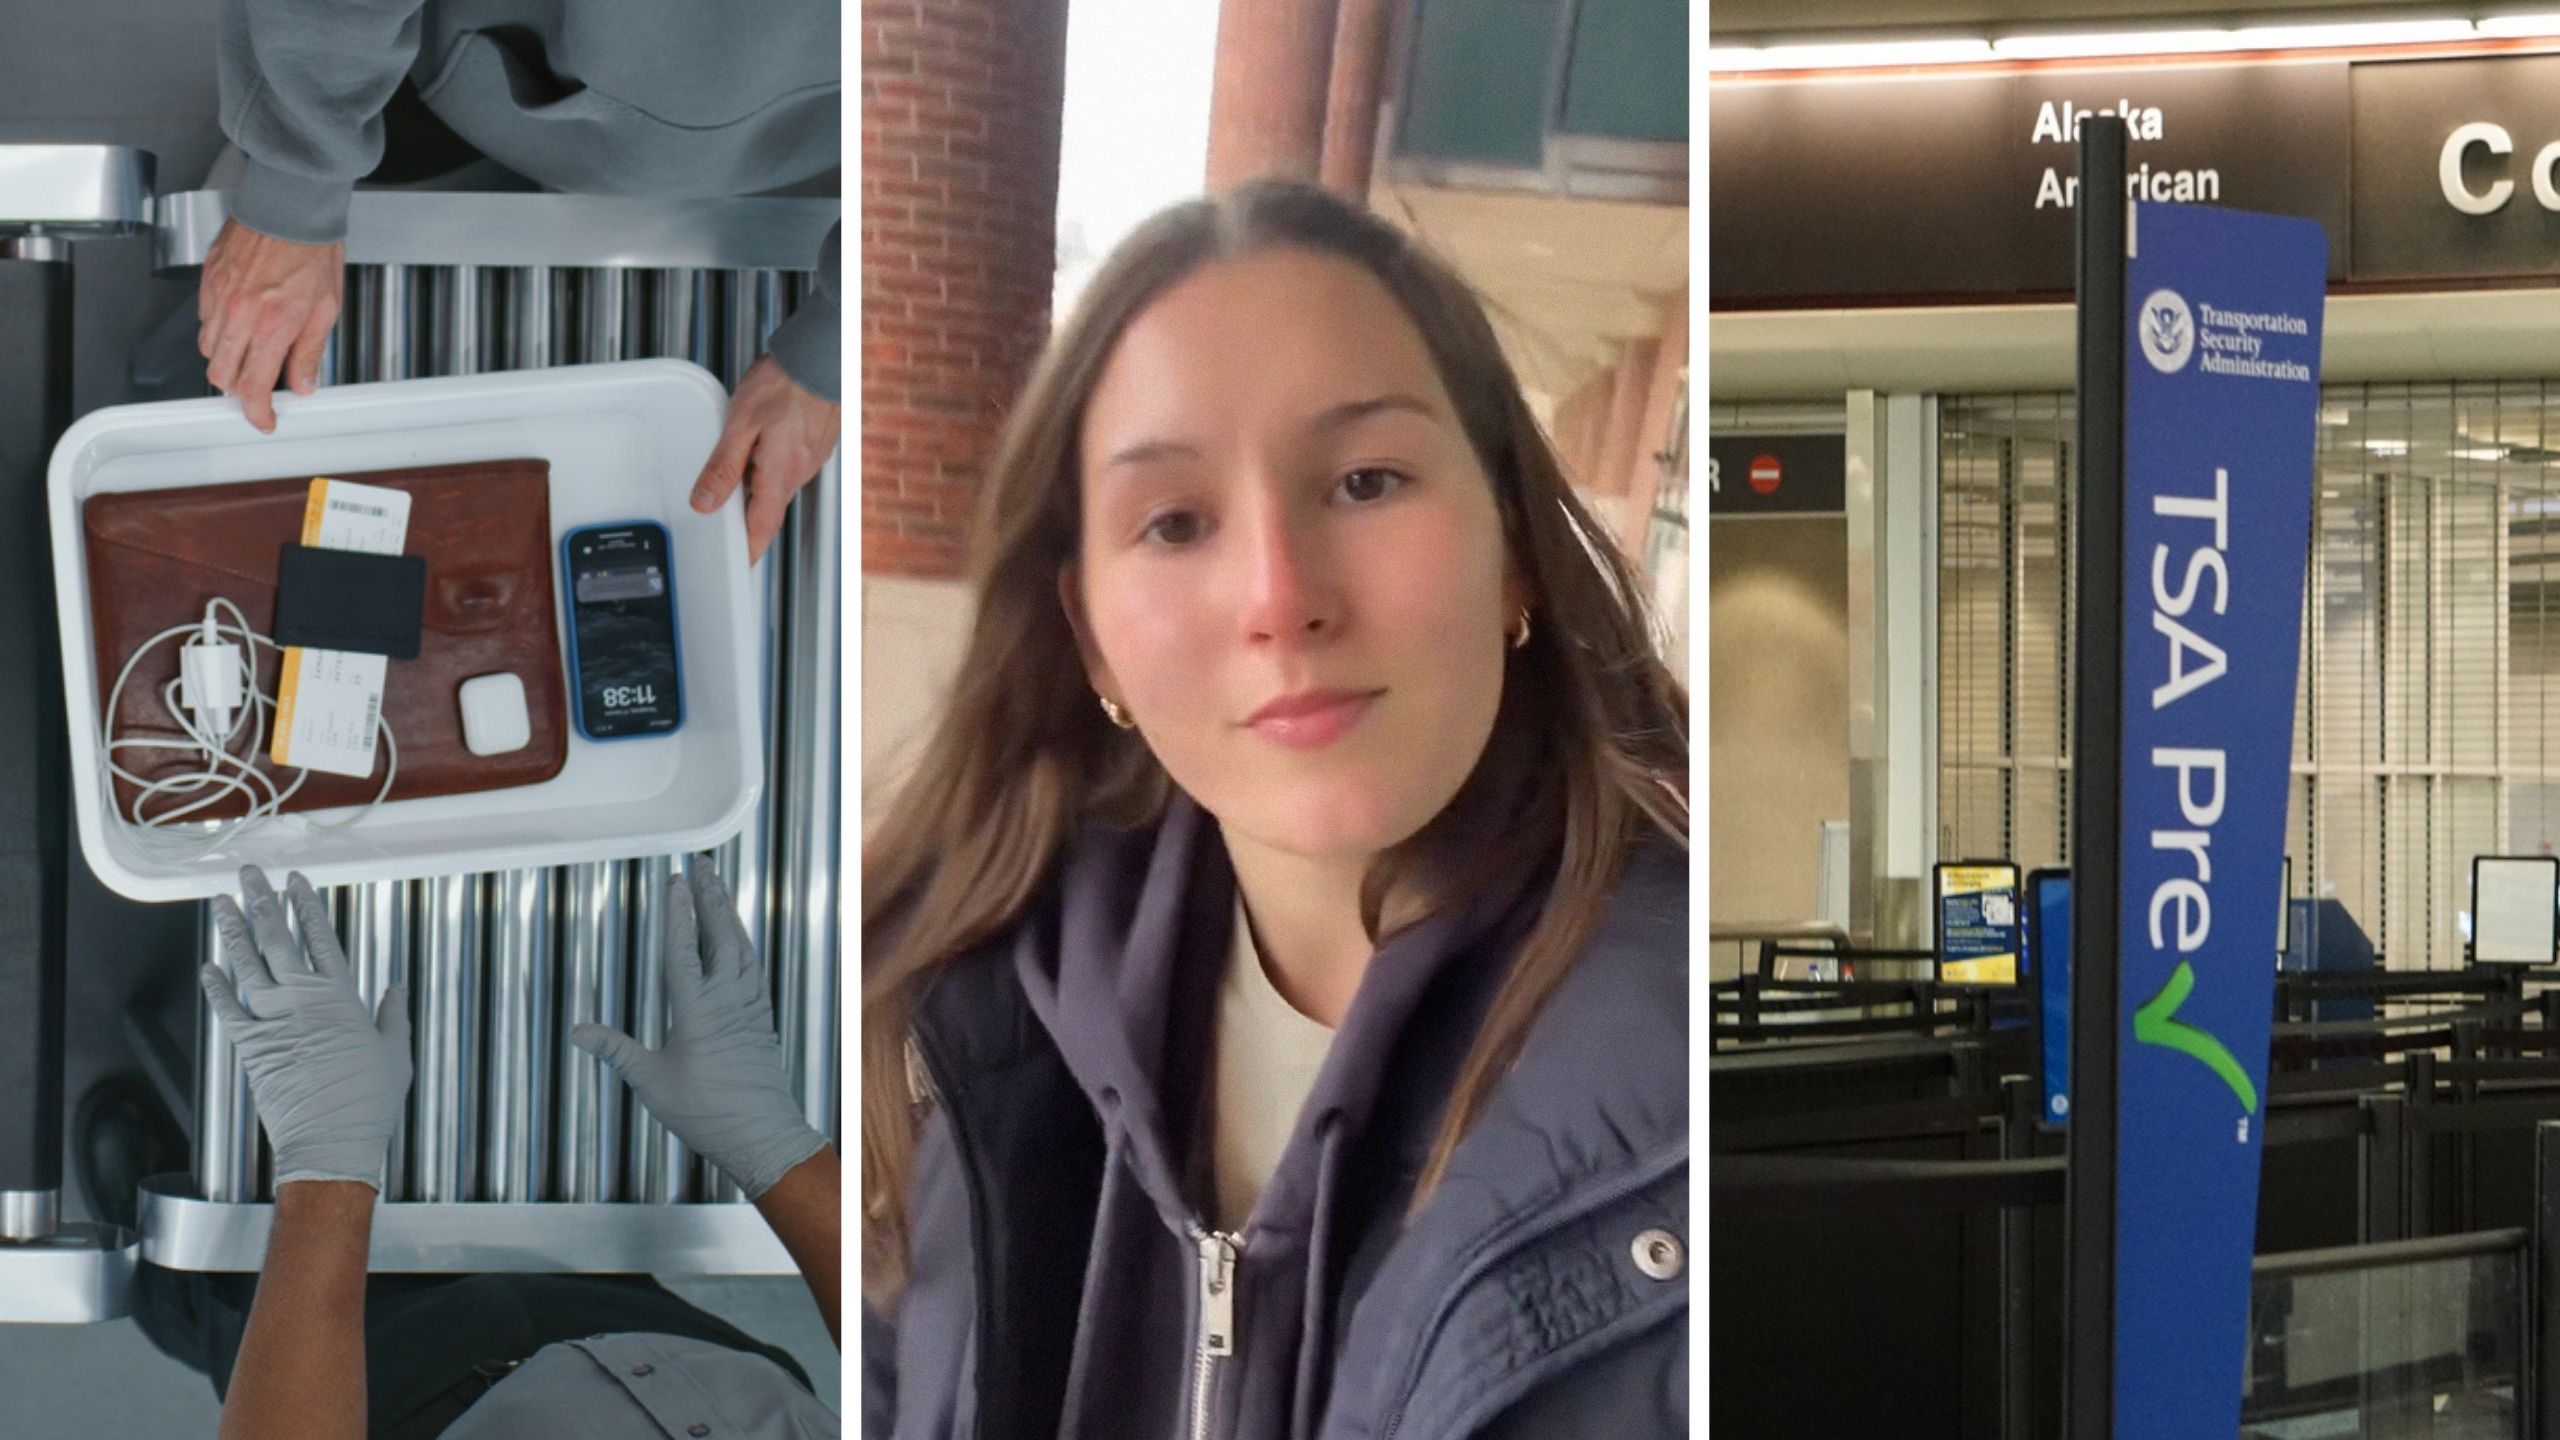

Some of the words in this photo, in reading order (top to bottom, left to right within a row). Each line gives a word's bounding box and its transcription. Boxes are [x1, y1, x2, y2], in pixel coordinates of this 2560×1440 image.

[2199, 303, 2308, 336] Transportation
[2200, 328, 2262, 358] Security
[2200, 351, 2311, 382] Administration
[2152, 467, 2228, 711] TSA
[603, 684, 657, 708] 11:38
[2149, 747, 2226, 952] Pre
